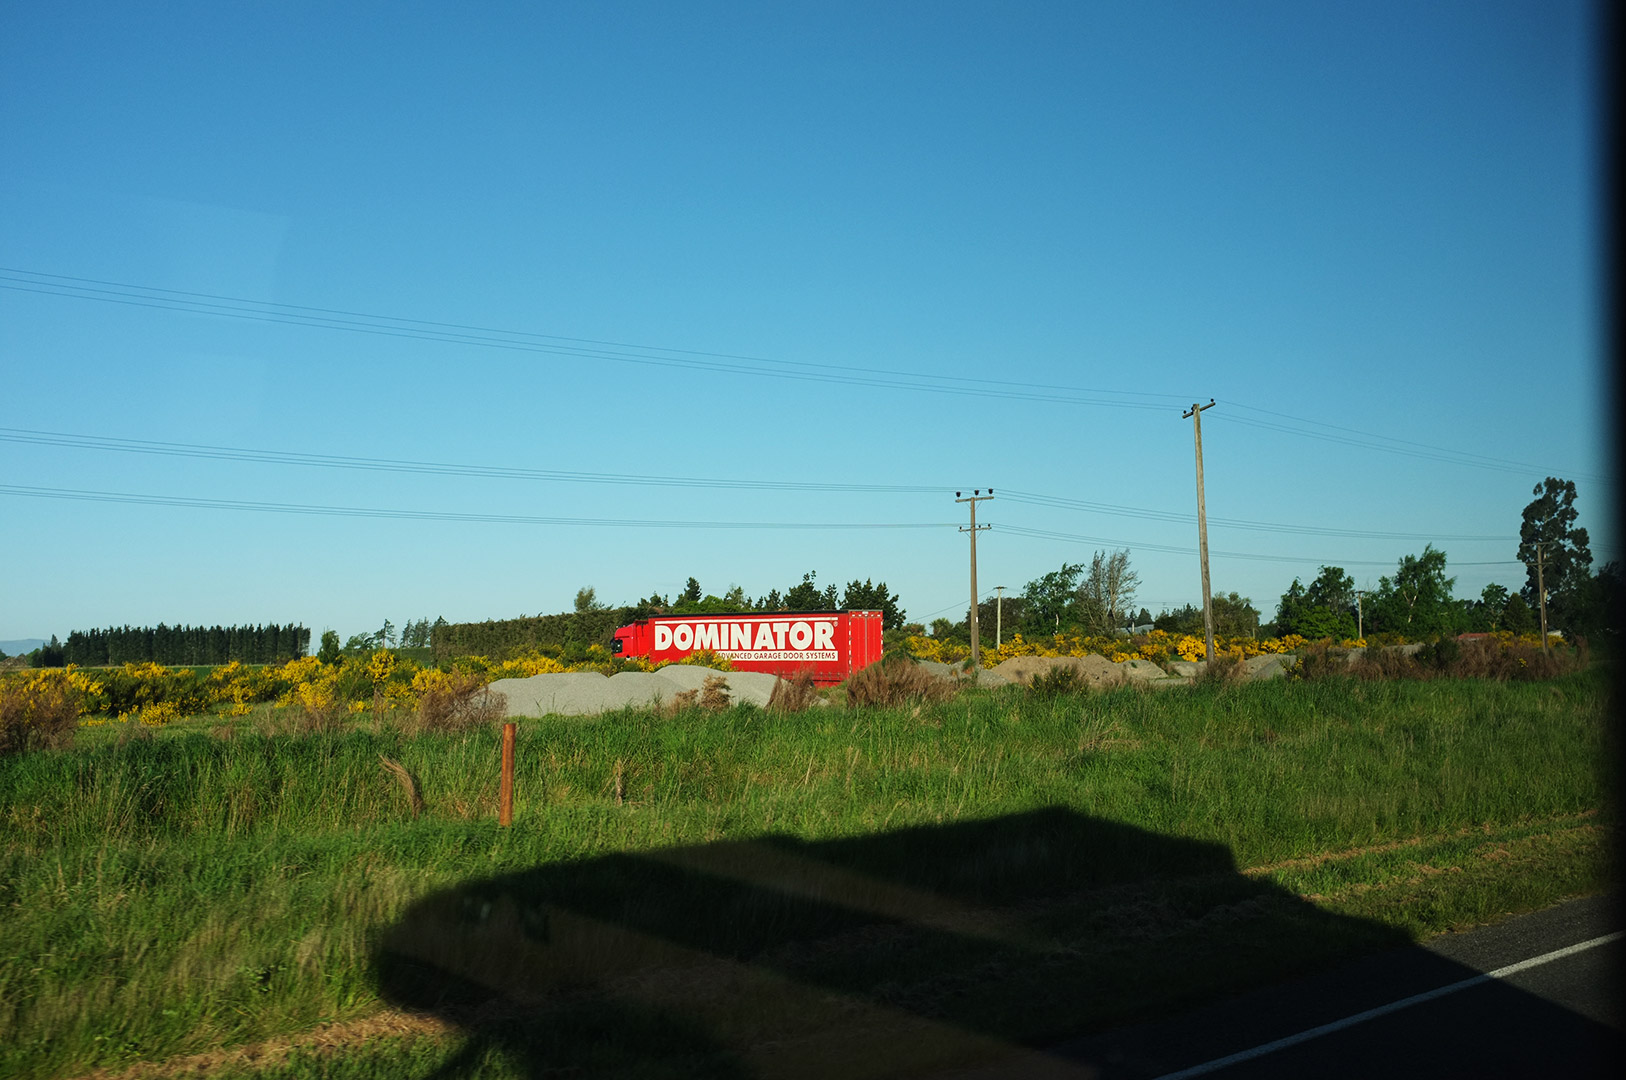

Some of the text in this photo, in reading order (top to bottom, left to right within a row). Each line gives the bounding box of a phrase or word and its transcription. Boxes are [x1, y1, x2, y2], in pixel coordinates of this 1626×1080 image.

[654, 622, 836, 651] DOMINATOR
[753, 652, 782, 660] GARAGE
[783, 652, 804, 660] DOOR
[805, 651, 836, 660] SYSTEMS
